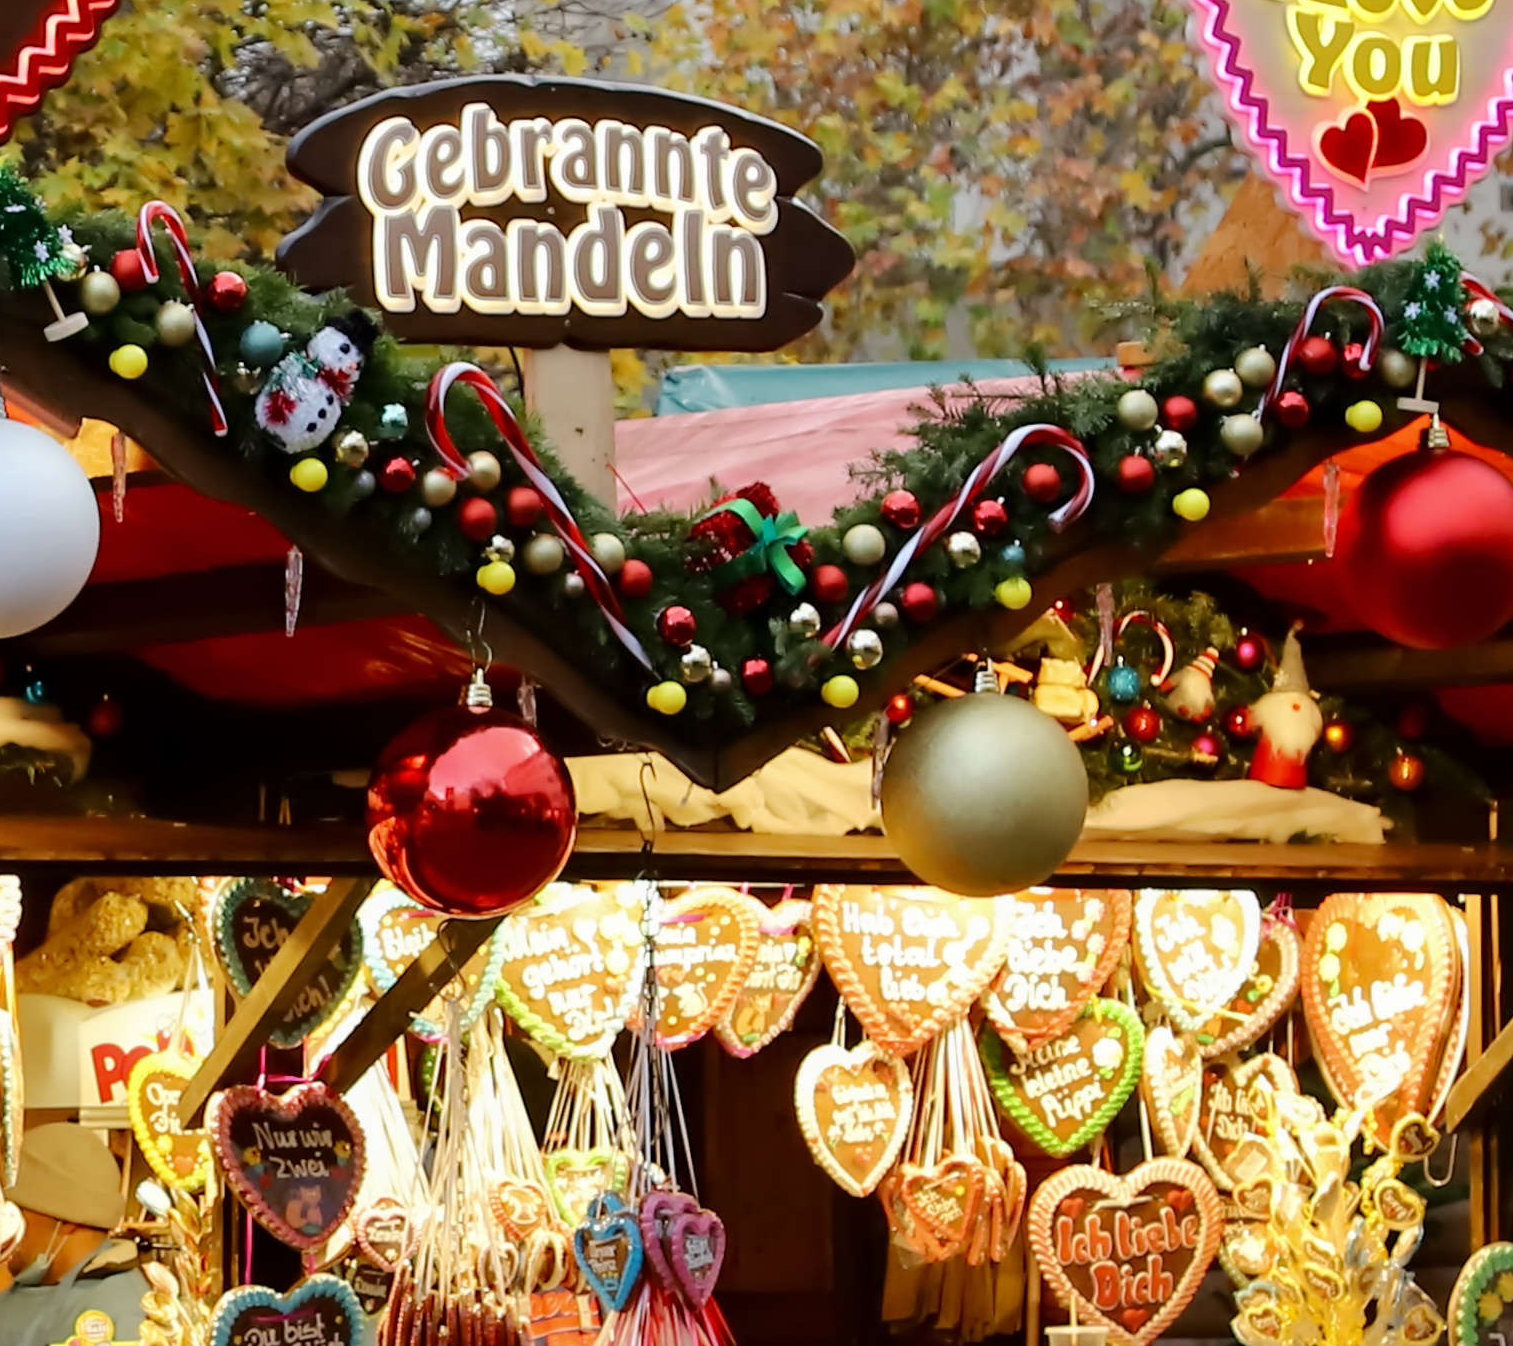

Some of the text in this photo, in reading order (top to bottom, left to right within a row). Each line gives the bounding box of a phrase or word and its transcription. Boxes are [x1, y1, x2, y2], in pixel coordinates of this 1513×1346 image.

[1286, 5, 1460, 105] You
[359, 103, 778, 235] Gebrannte
[373, 200, 766, 318] Mandeln
[861, 934, 943, 969] total
[252, 1121, 333, 1151] Nur wir
[1057, 1206, 1199, 1266] Ich liebe
[1090, 1254, 1173, 1311] Dich
[283, 1313, 325, 1343] bist
